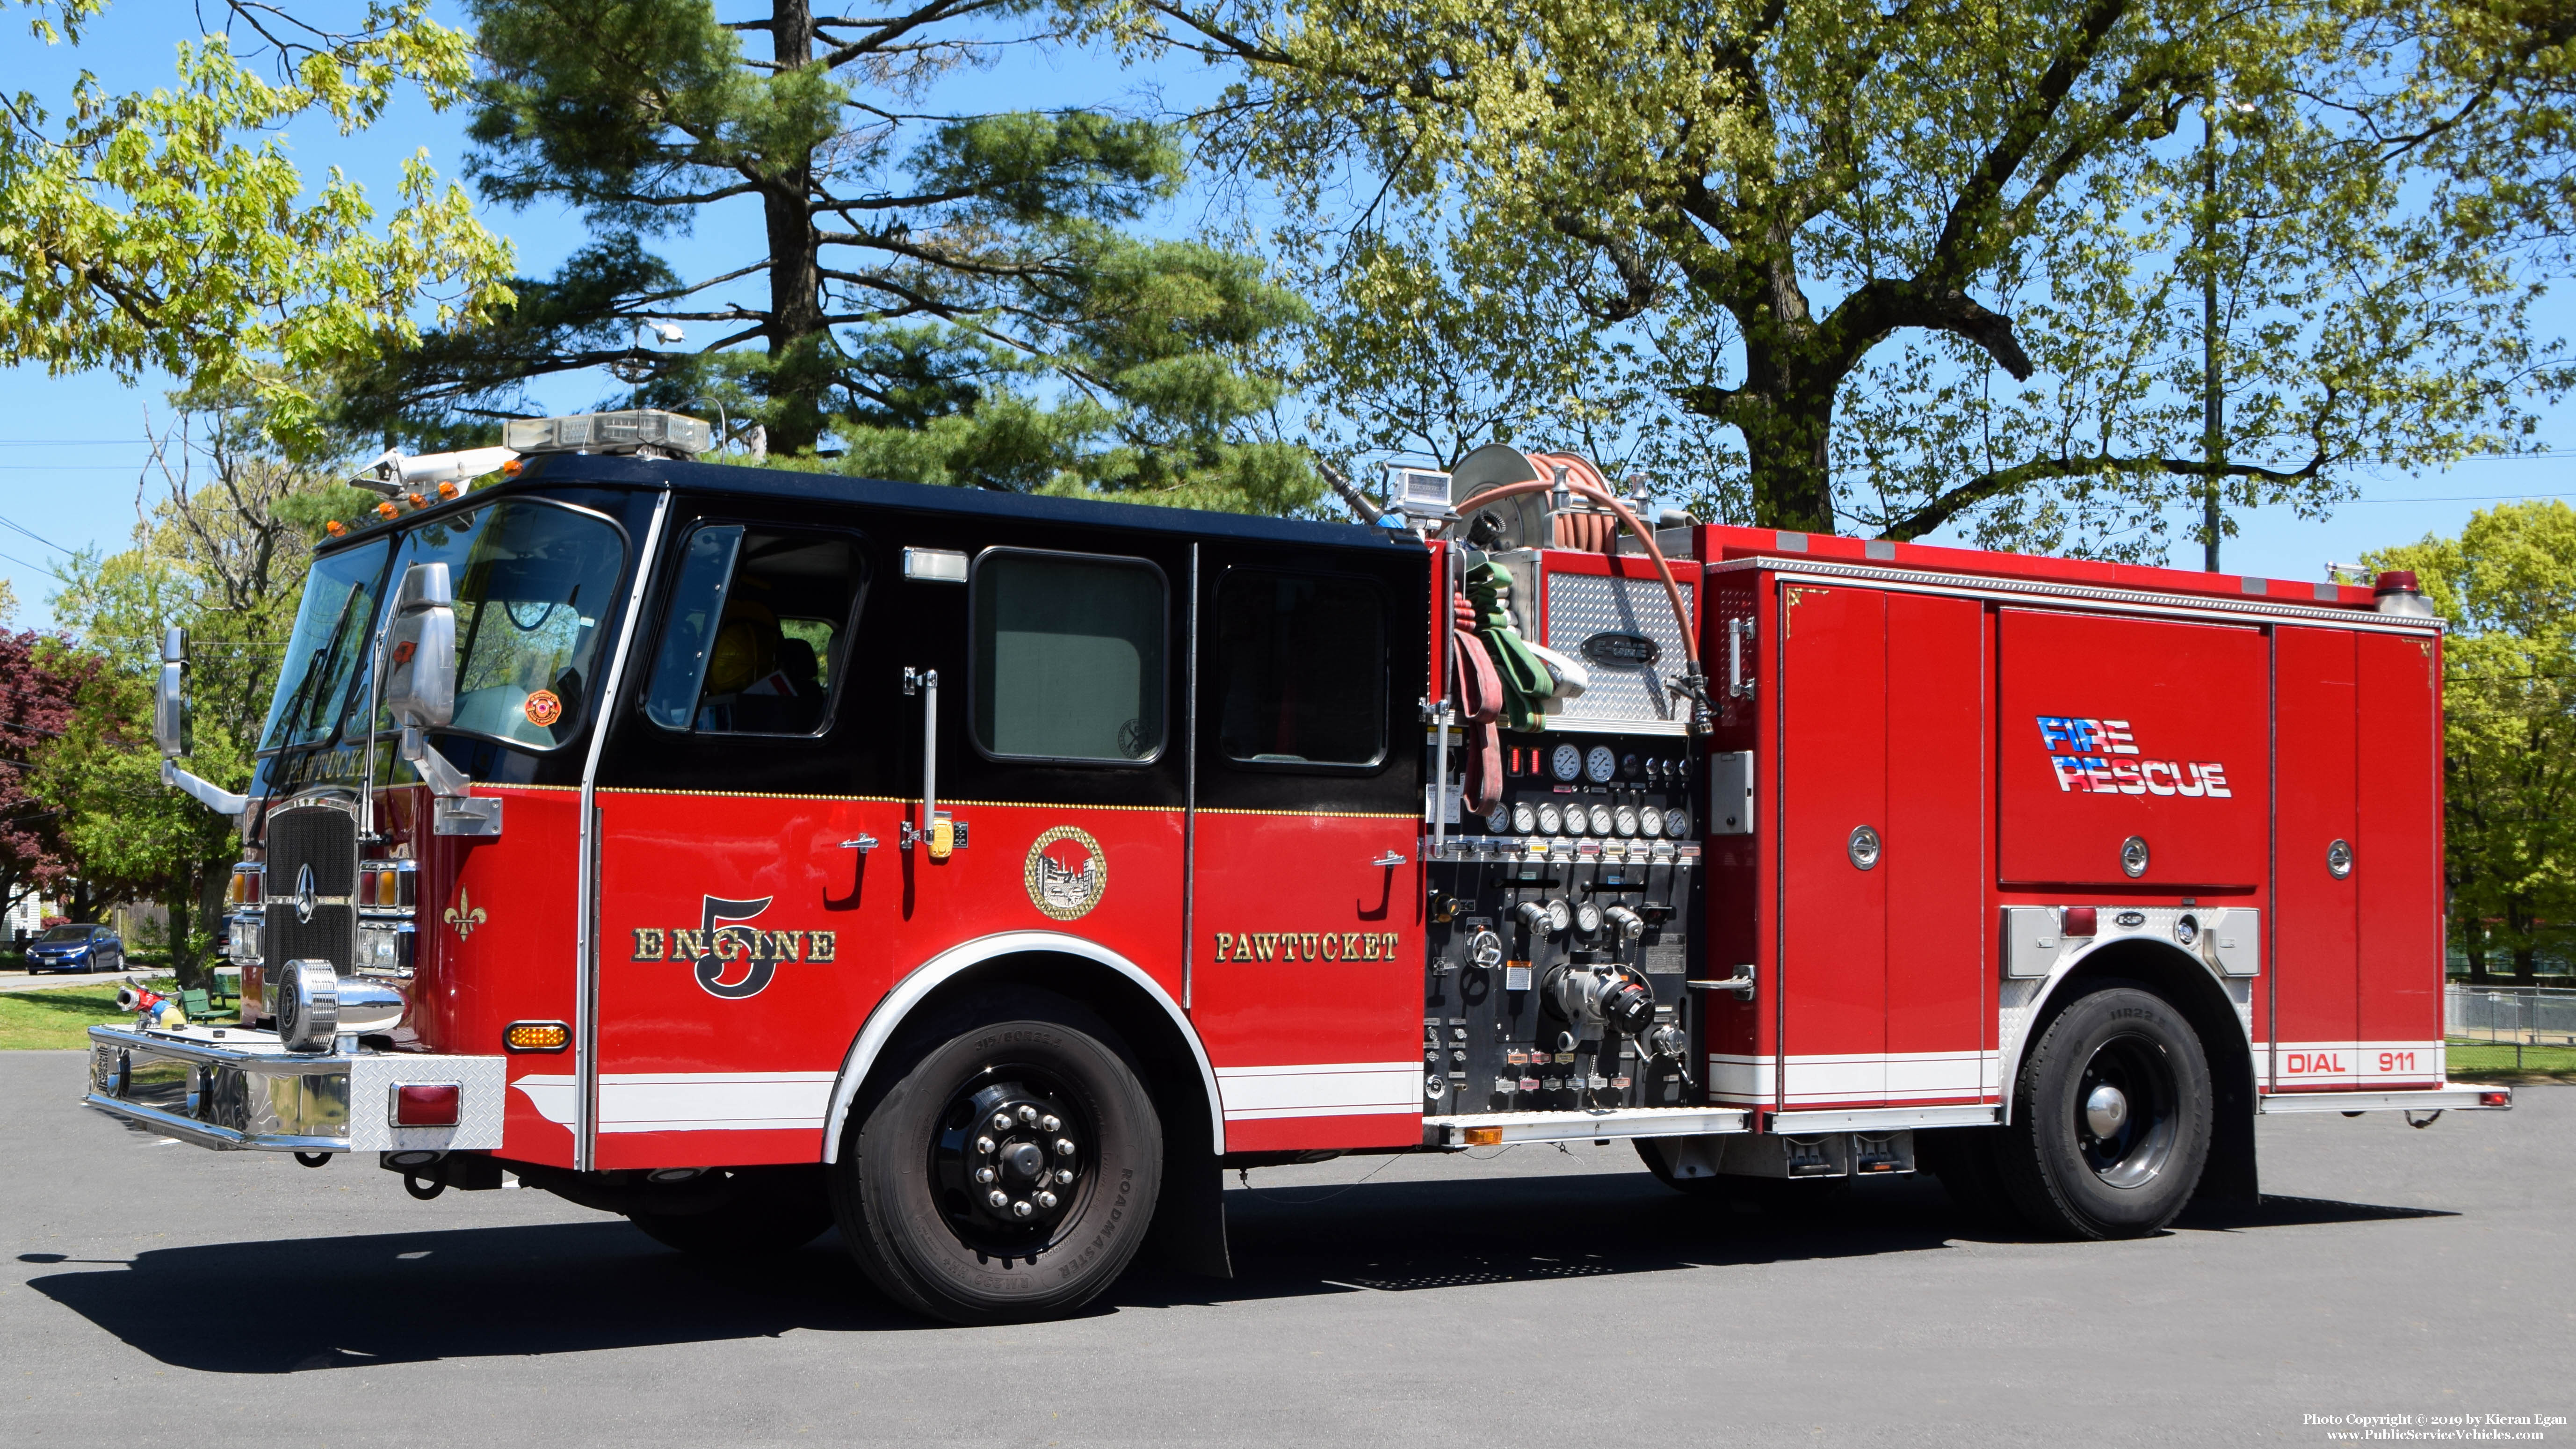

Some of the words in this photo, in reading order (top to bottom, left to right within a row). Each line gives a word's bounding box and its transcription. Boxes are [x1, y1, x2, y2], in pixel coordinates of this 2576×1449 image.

[1594, 639, 1647, 658] E-ONE
[2036, 715, 2140, 755] FIRE
[2050, 754, 2232, 797] RESCUE
[1029, 884, 1090, 918] INCORPORATED
[1091, 885, 1102, 903] 1886
[630, 928, 836, 964] ENGINE
[695, 894, 774, 1000] 5
[1215, 932, 1399, 963] PAWTUCKET
[2287, 1053, 2345, 1073] DIAL
[2379, 1051, 2415, 1072] 911
[1059, 1167, 1133, 1279] ROADMASTER
